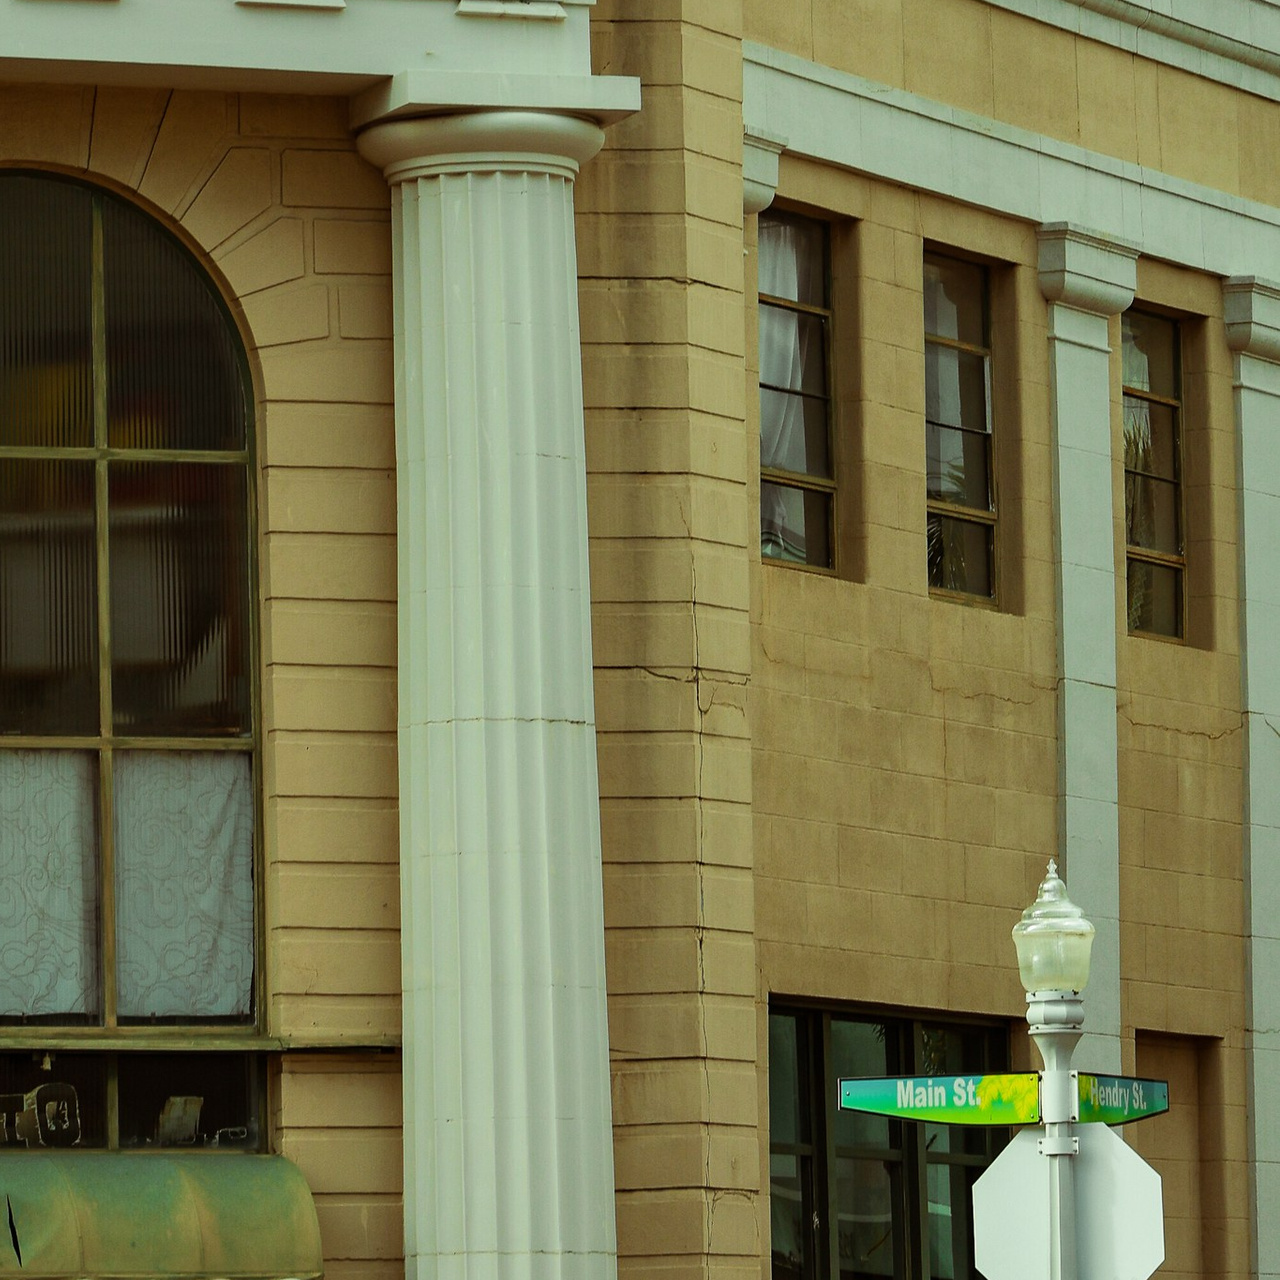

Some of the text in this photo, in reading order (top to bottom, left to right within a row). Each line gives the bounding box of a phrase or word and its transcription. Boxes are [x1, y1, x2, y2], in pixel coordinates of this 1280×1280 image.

[897, 1077, 981, 1108] Main St.
[1090, 1078, 1147, 1115] Hendry St.
